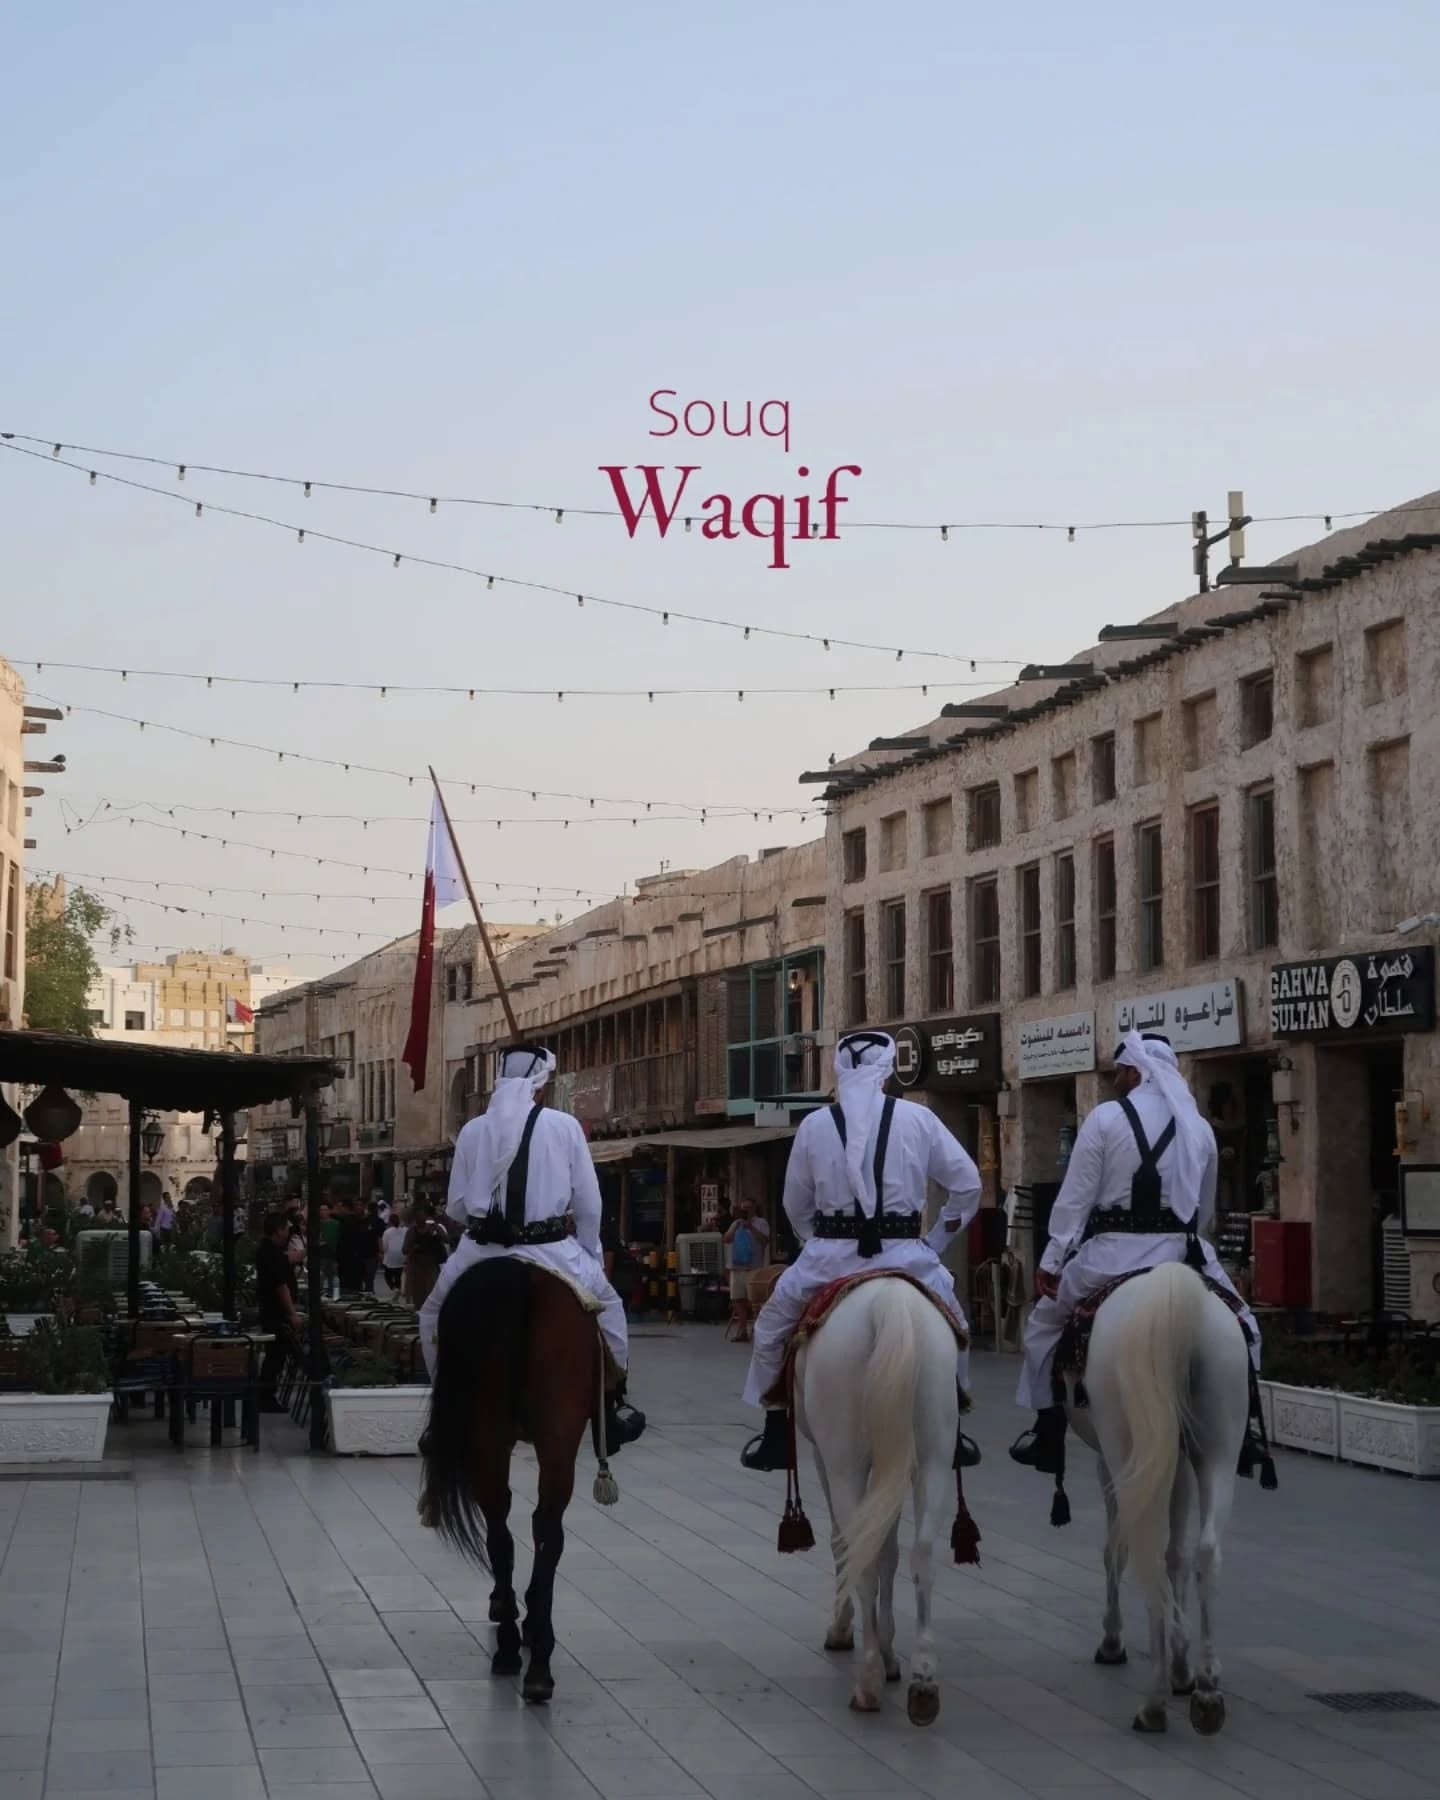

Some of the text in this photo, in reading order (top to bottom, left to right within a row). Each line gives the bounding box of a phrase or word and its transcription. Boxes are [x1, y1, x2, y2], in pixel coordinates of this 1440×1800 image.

[1271, 965, 1329, 1000] GAHWA
[1367, 953, 1416, 988] قهوة
[1118, 1000, 1165, 1033] للتراث
[1271, 999, 1330, 1033] SULTAN
[1364, 989, 1416, 1026] سلطان
